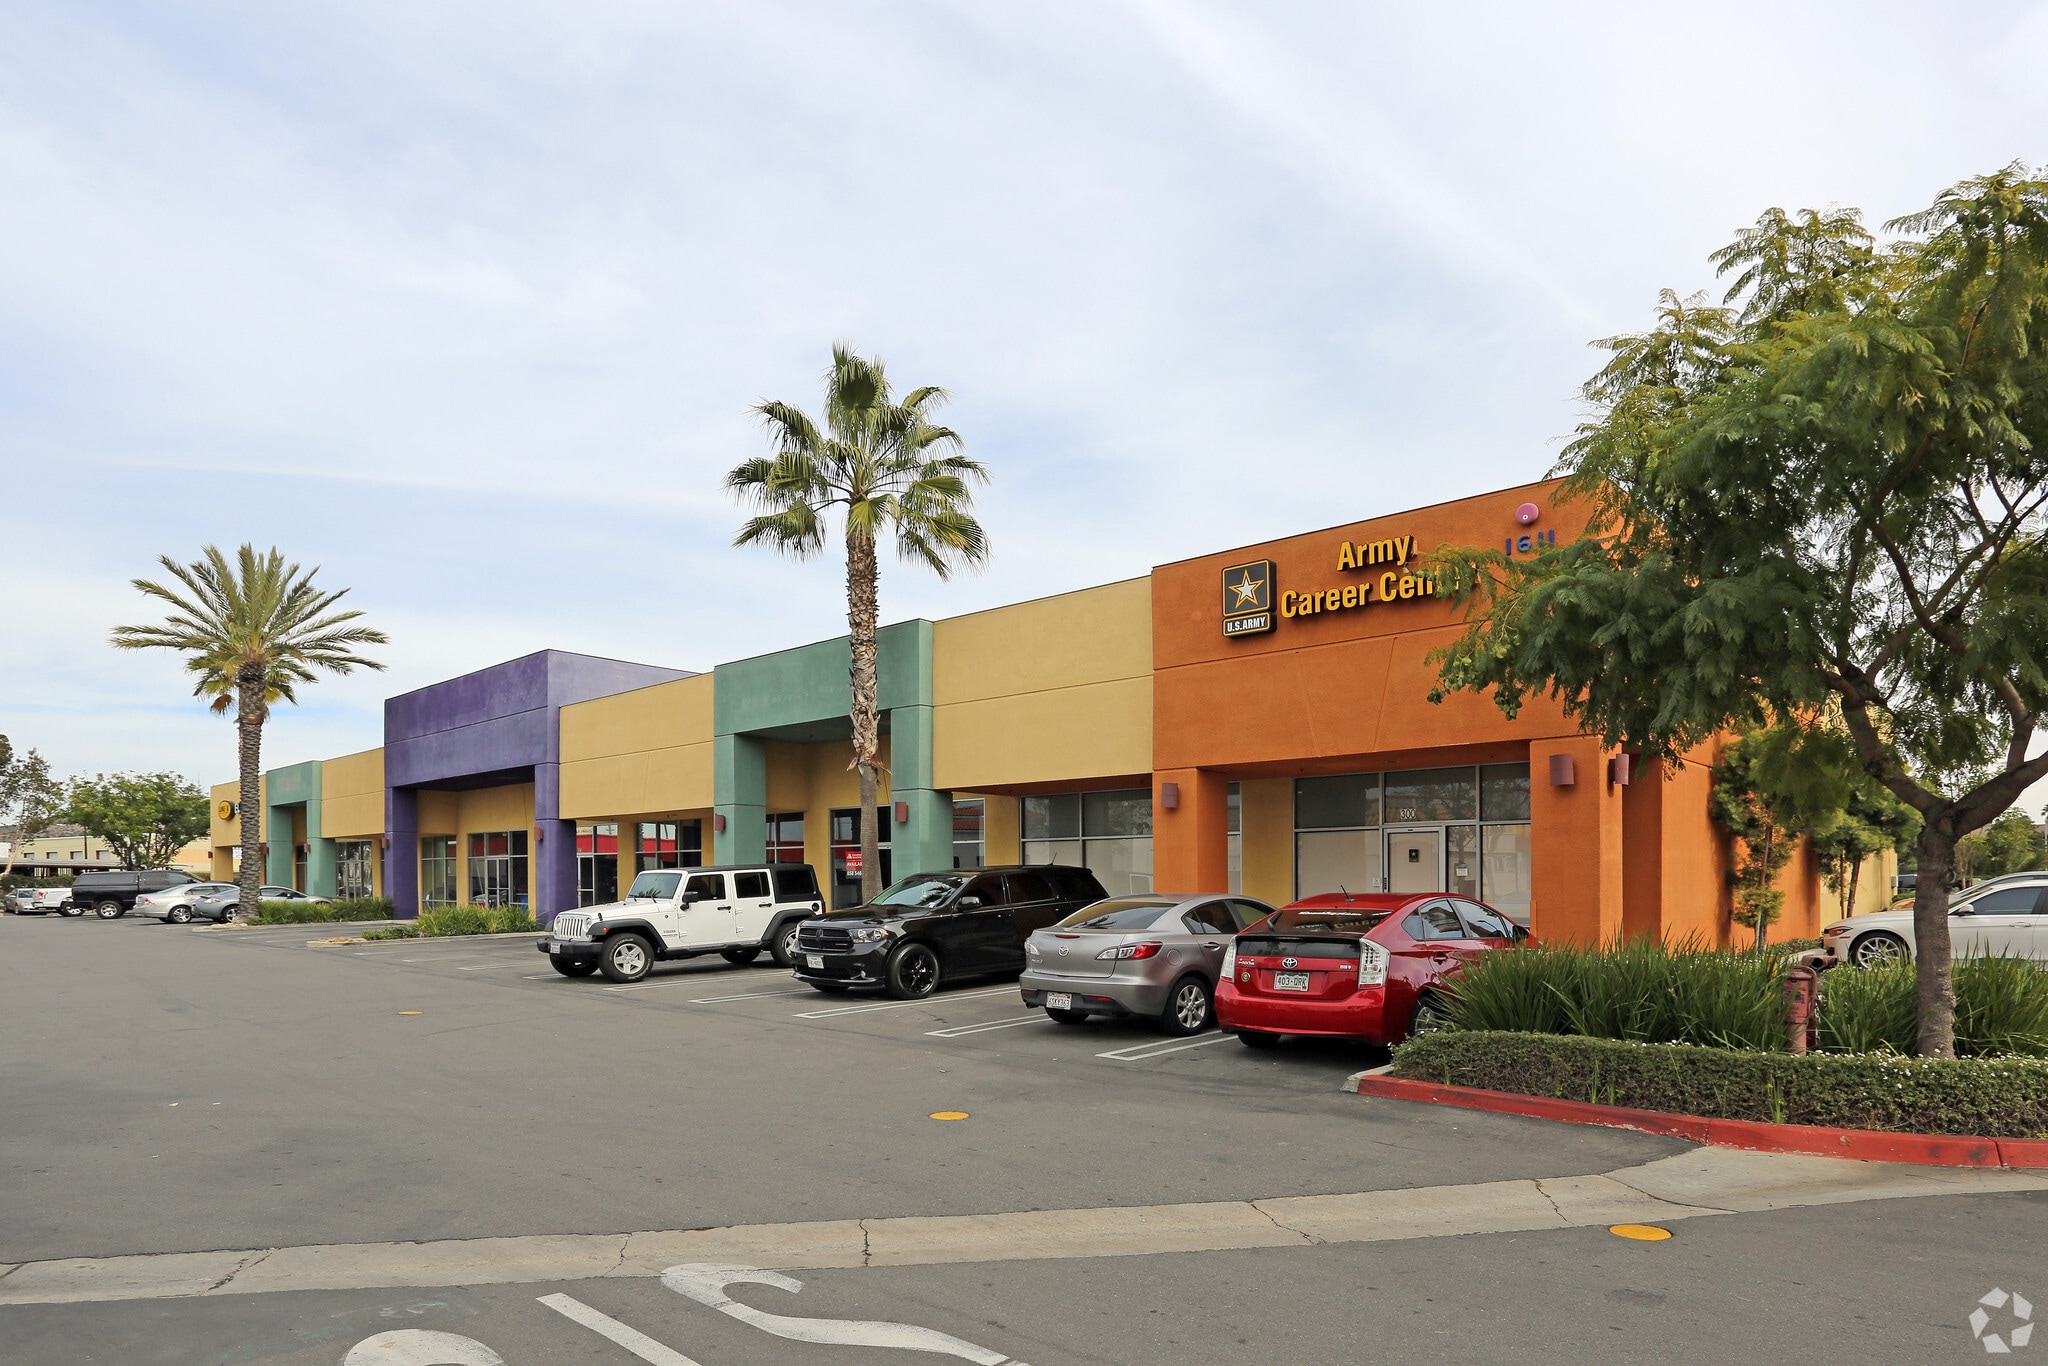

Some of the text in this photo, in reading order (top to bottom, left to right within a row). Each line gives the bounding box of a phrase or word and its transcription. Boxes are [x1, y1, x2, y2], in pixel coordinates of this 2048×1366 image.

[1337, 535, 1410, 571] Army
[1506, 528, 1554, 556] 1611
[1281, 582, 1370, 618] Career
[1400, 808, 1417, 820] 300
